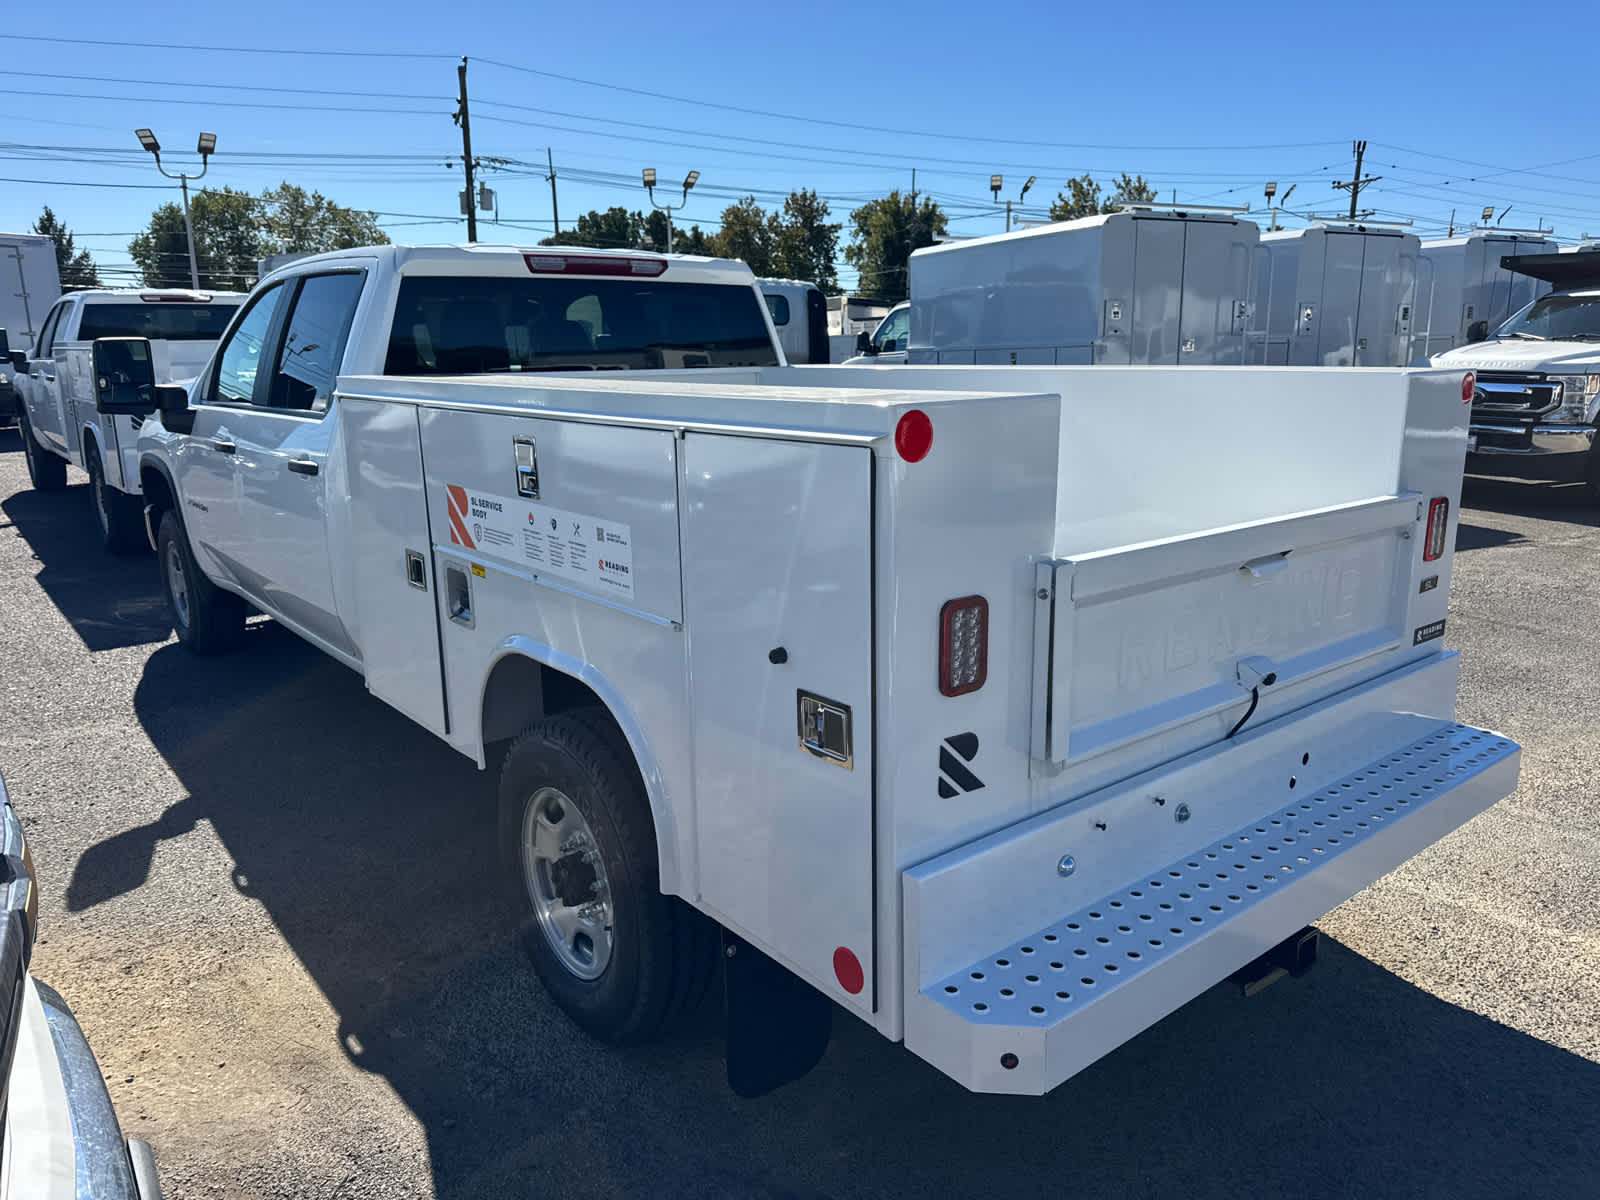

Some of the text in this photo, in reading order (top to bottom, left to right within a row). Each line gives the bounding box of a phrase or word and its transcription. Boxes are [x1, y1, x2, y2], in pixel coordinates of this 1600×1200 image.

[471, 496, 503, 513] SL SERVICE
[472, 507, 487, 519] BODY
[605, 560, 629, 574] READING
[1423, 623, 1443, 635] READING
